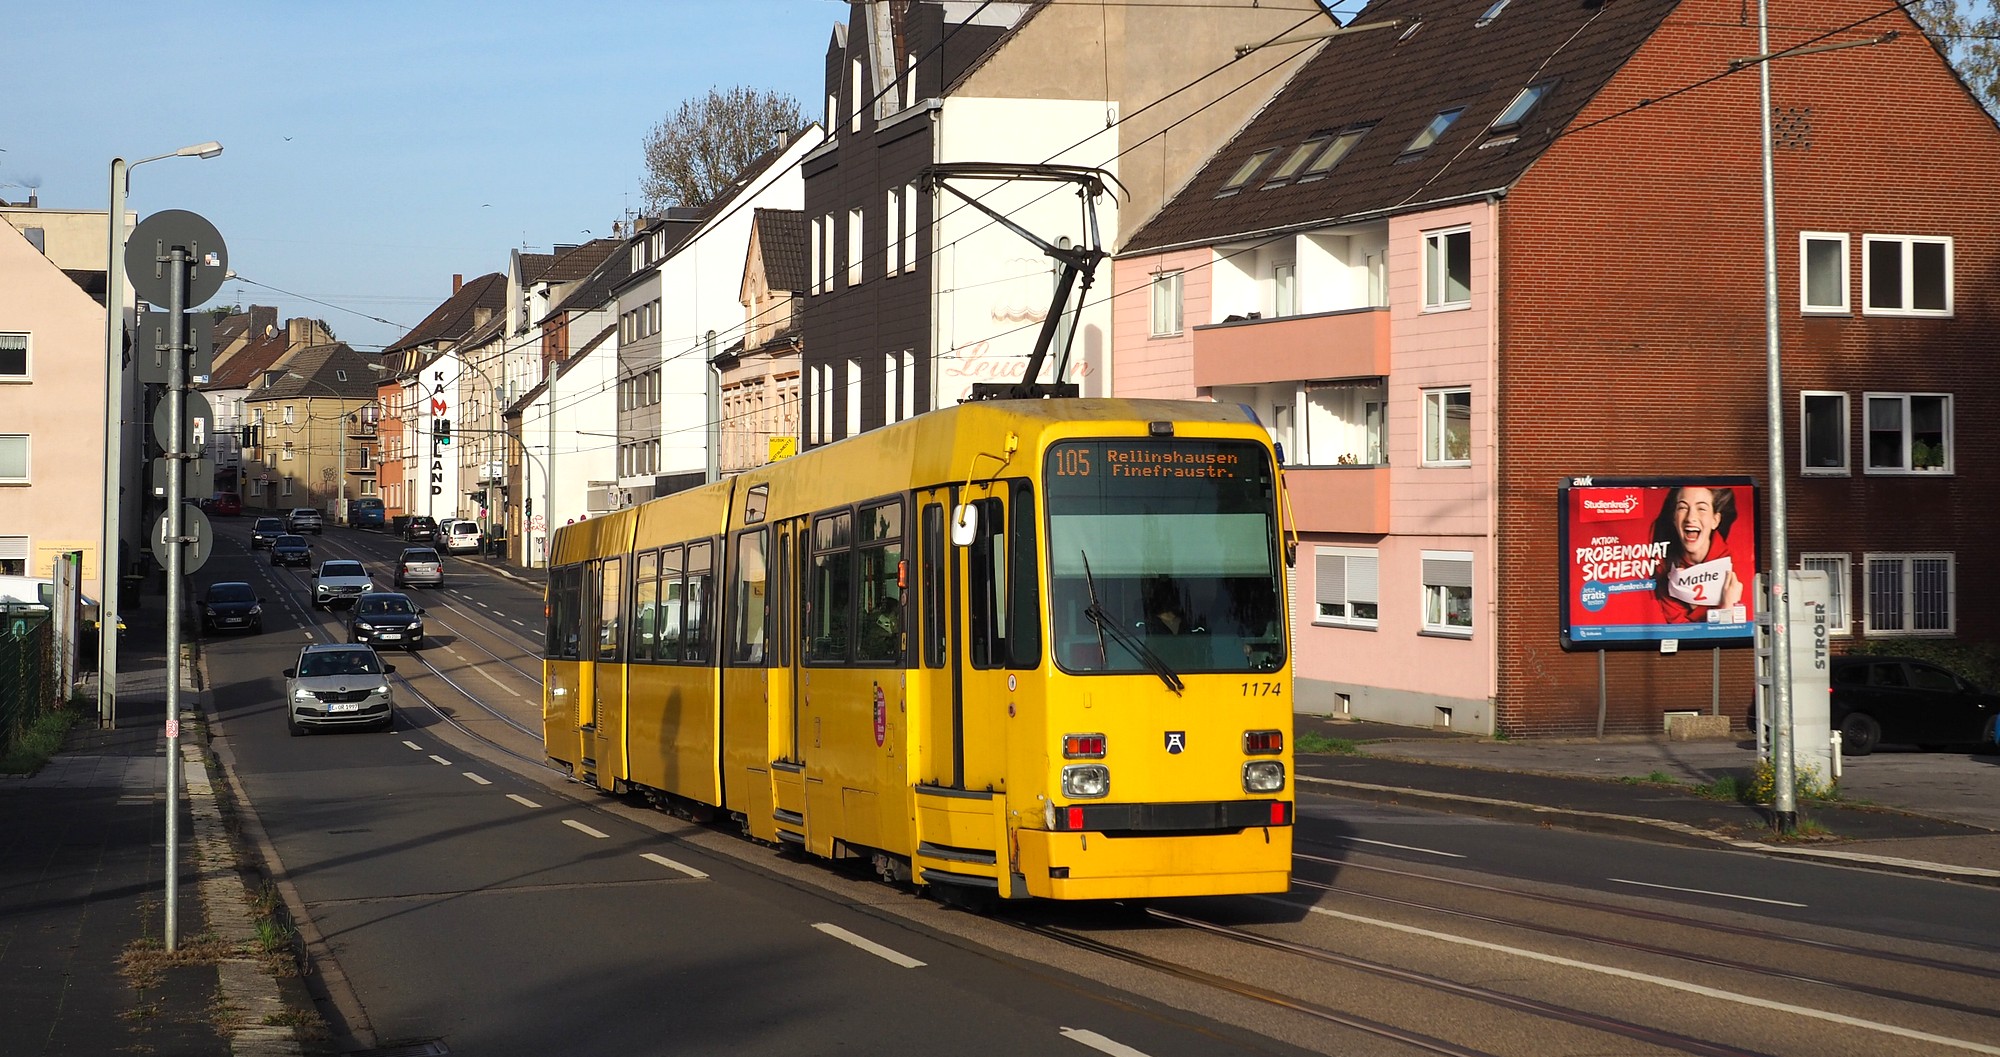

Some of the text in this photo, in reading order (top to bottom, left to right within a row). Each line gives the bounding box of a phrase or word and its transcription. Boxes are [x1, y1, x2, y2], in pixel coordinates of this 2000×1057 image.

[945, 340, 1095, 377] Leucn
[432, 371, 447, 495] KAMLAND
[1056, 449, 1090, 476] 105
[1107, 450, 1238, 464] Rellinghausen
[1113, 464, 1234, 478] Finefraustr.
[1573, 475, 1593, 486] awk
[1583, 499, 1630, 509] Studienkreis
[1591, 536, 1619, 546] AKTION:
[1576, 541, 1671, 564] PROBEMONAT
[1608, 581, 1653, 591] studienkreis.de
[1678, 570, 1719, 587] Mathe
[1582, 590, 1606, 602] gratis
[1692, 584, 1708, 601] 2
[1814, 603, 1826, 670] STRÖER
[1241, 682, 1282, 697] 1174
